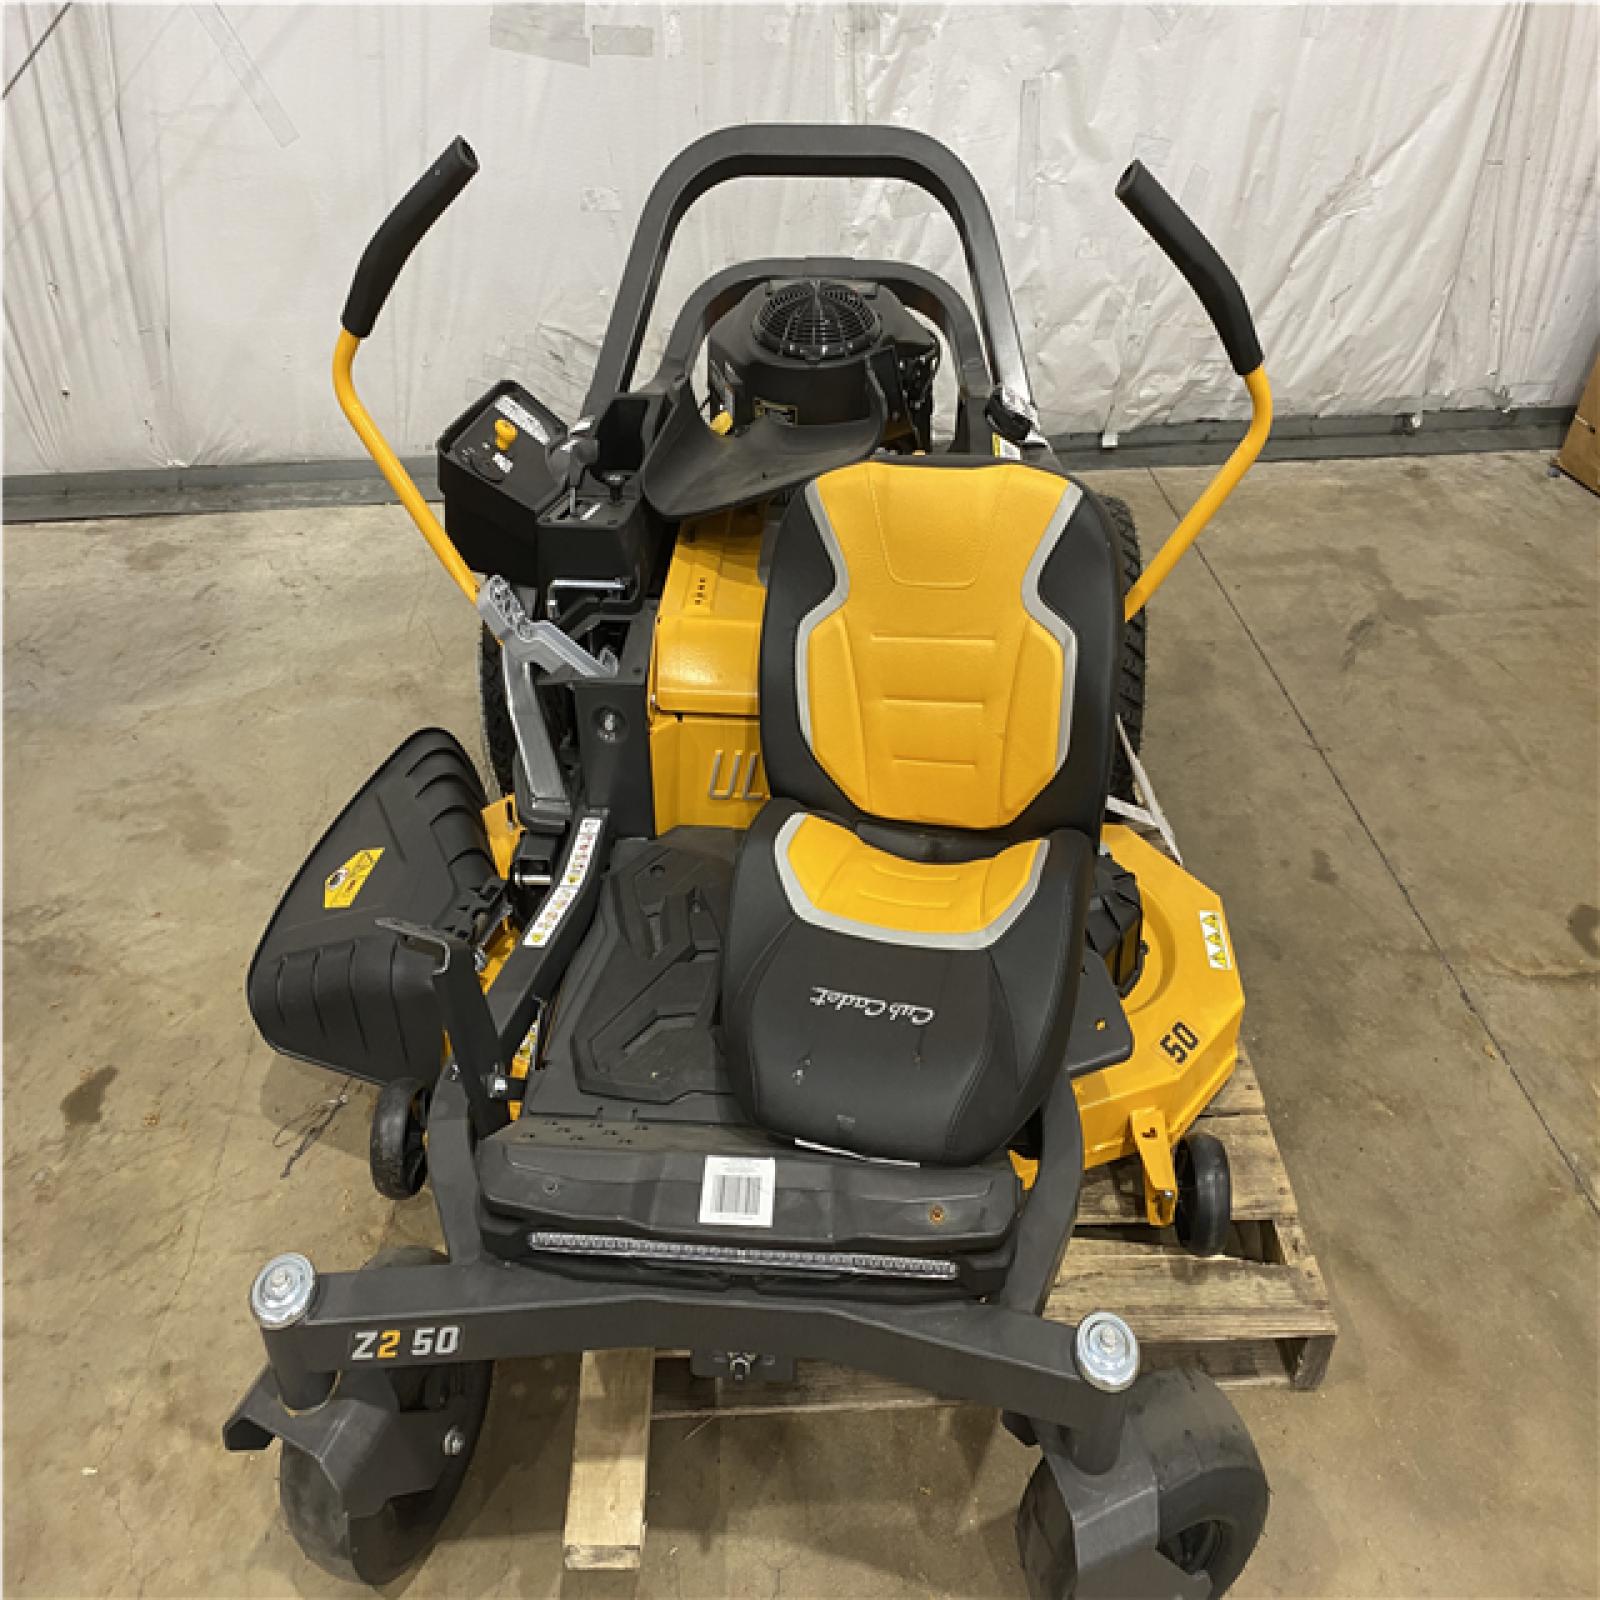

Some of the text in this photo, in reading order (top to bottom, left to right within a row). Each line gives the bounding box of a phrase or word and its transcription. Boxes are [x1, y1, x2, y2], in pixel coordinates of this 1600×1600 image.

[809, 986, 935, 1025] Cub Cadet
[1160, 1021, 1199, 1064] 50
[351, 1326, 460, 1360] Z2 50
